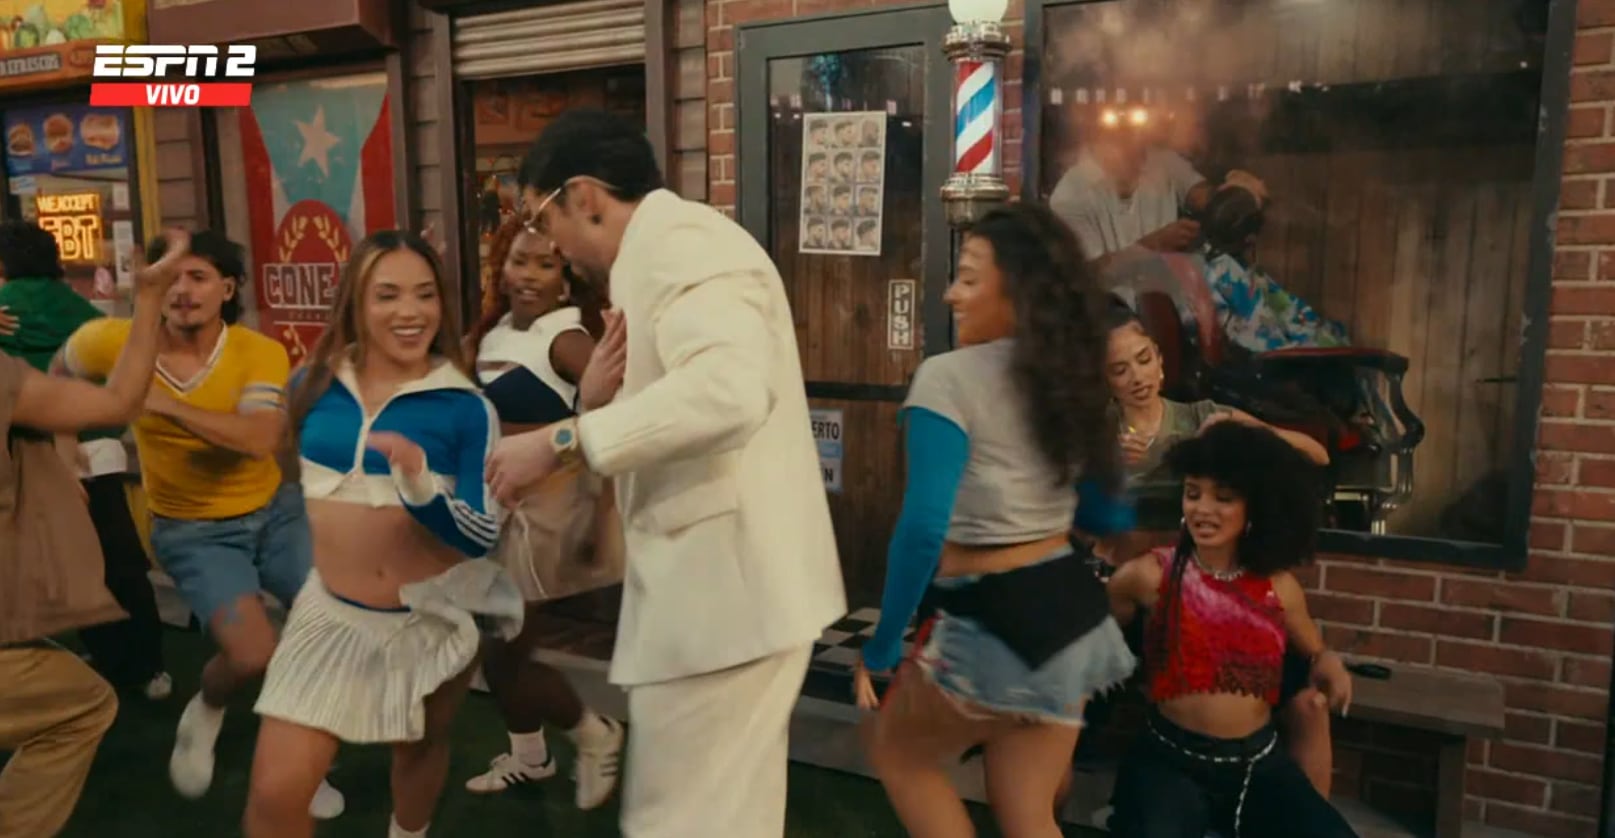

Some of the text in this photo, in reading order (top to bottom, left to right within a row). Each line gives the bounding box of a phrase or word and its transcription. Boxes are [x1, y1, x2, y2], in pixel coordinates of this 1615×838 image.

[262, 263, 341, 309] CONE
[893, 284, 910, 345] PUSH
[811, 421, 840, 440] ERTO
